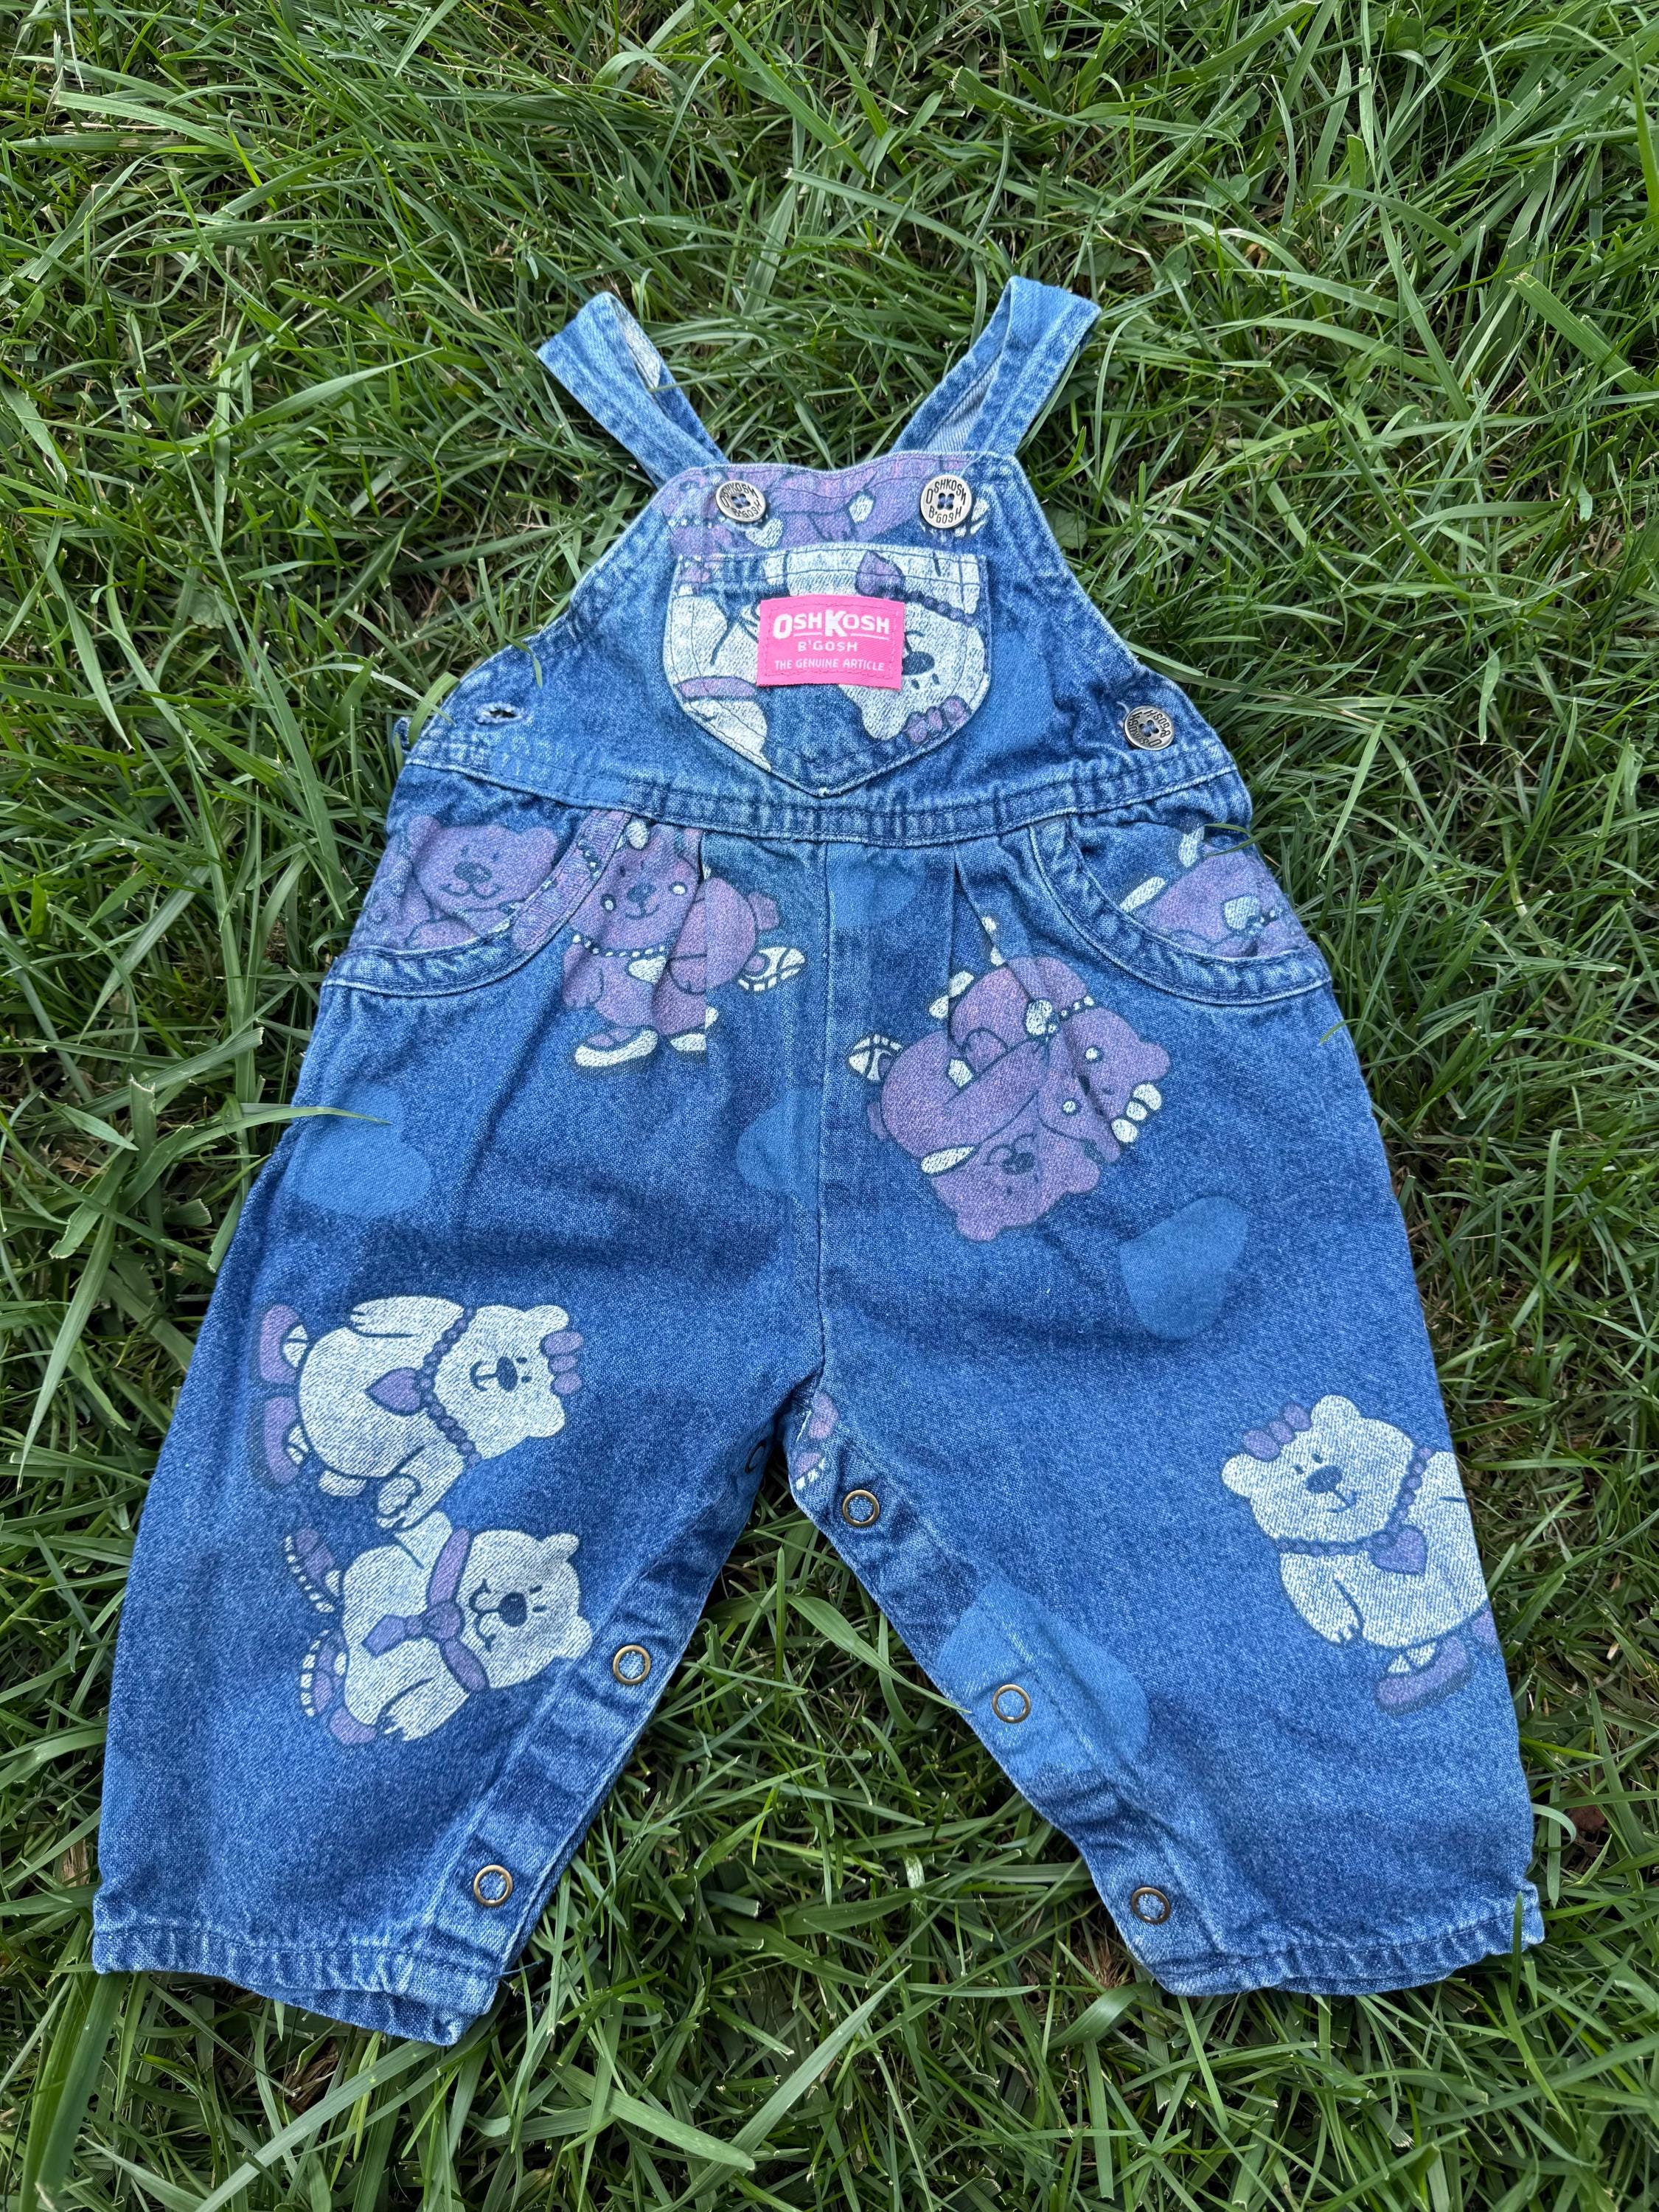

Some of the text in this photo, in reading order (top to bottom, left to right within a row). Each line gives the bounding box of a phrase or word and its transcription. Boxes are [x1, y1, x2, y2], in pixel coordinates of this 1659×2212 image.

[926, 479, 966, 506] OSHKOSH
[797, 641, 858, 652] B'GOSH
[775, 658, 885, 672] THE GENUINE ARTICLE
